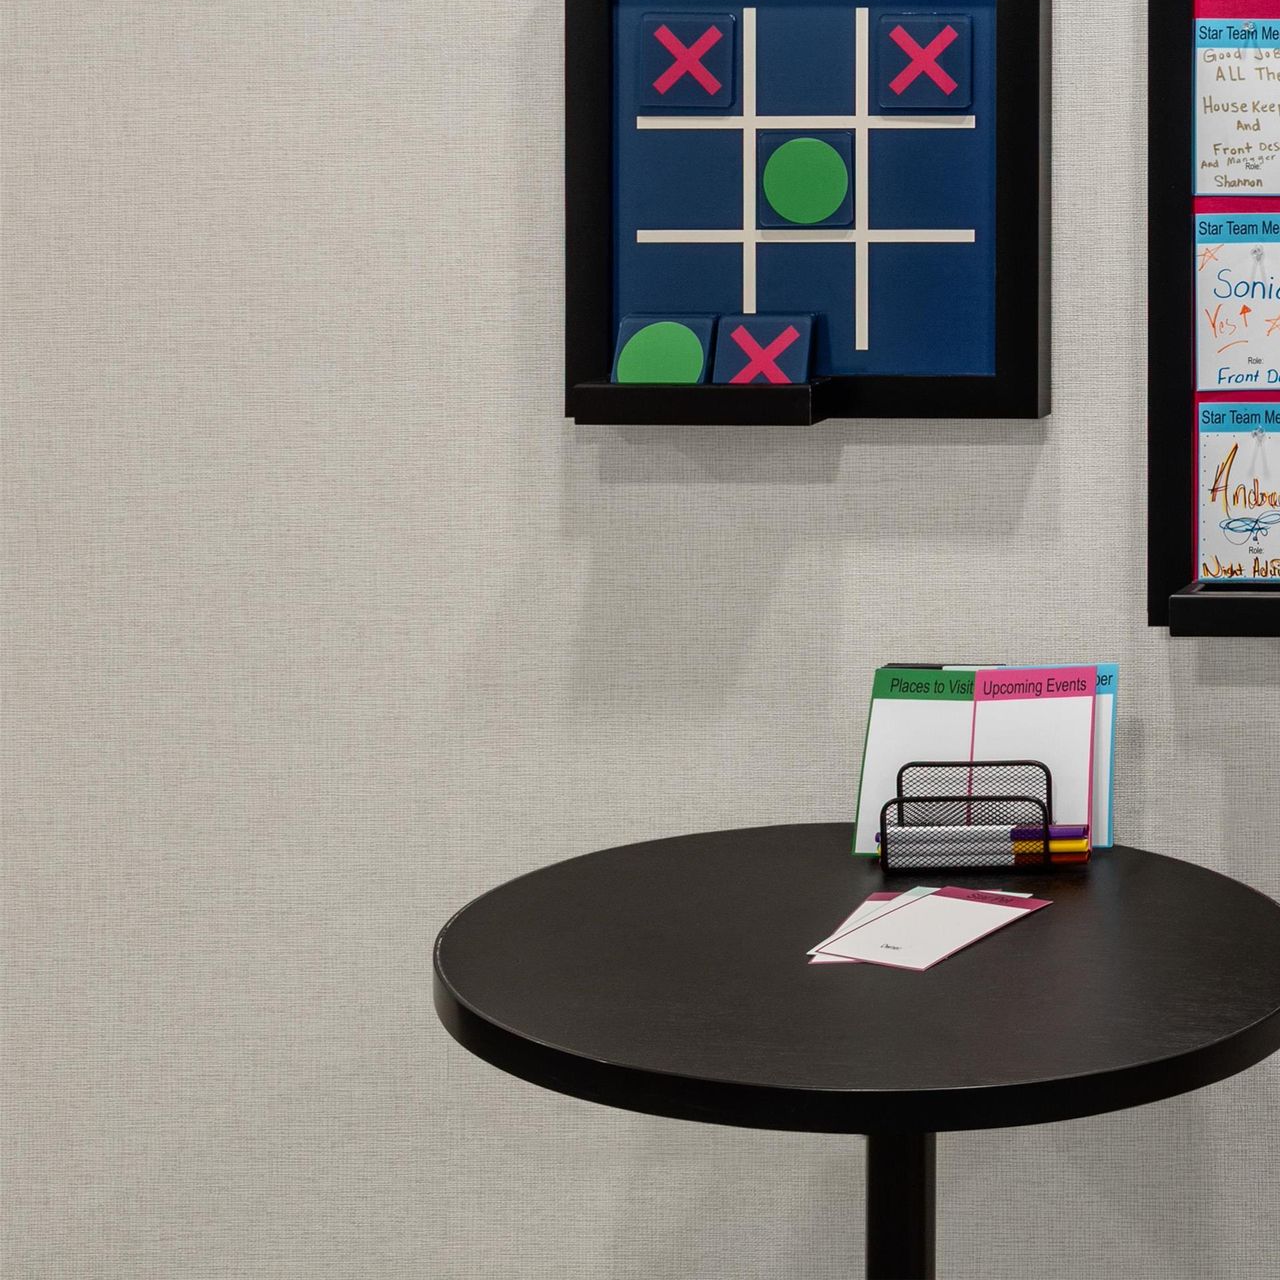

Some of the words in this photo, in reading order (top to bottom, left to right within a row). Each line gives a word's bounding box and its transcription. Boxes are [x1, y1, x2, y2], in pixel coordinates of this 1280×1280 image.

[1199, 26, 1223, 40] Star
[1227, 26, 1258, 40] Team
[1203, 48, 1242, 63] Good
[1236, 118, 1261, 131] And
[1213, 141, 1253, 156] Front
[1214, 174, 1264, 188] Shannon
[1199, 222, 1224, 236] Star
[1227, 221, 1259, 236] Team
[1205, 303, 1237, 338] Yes
[1218, 367, 1260, 384] Front
[1201, 410, 1226, 424] Star
[1229, 410, 1261, 424] Team
[889, 678, 930, 694] Places
[931, 679, 945, 695] to
[948, 679, 975, 695] Visit
[982, 679, 1043, 698] Upcoming
[1046, 677, 1088, 693] Events
